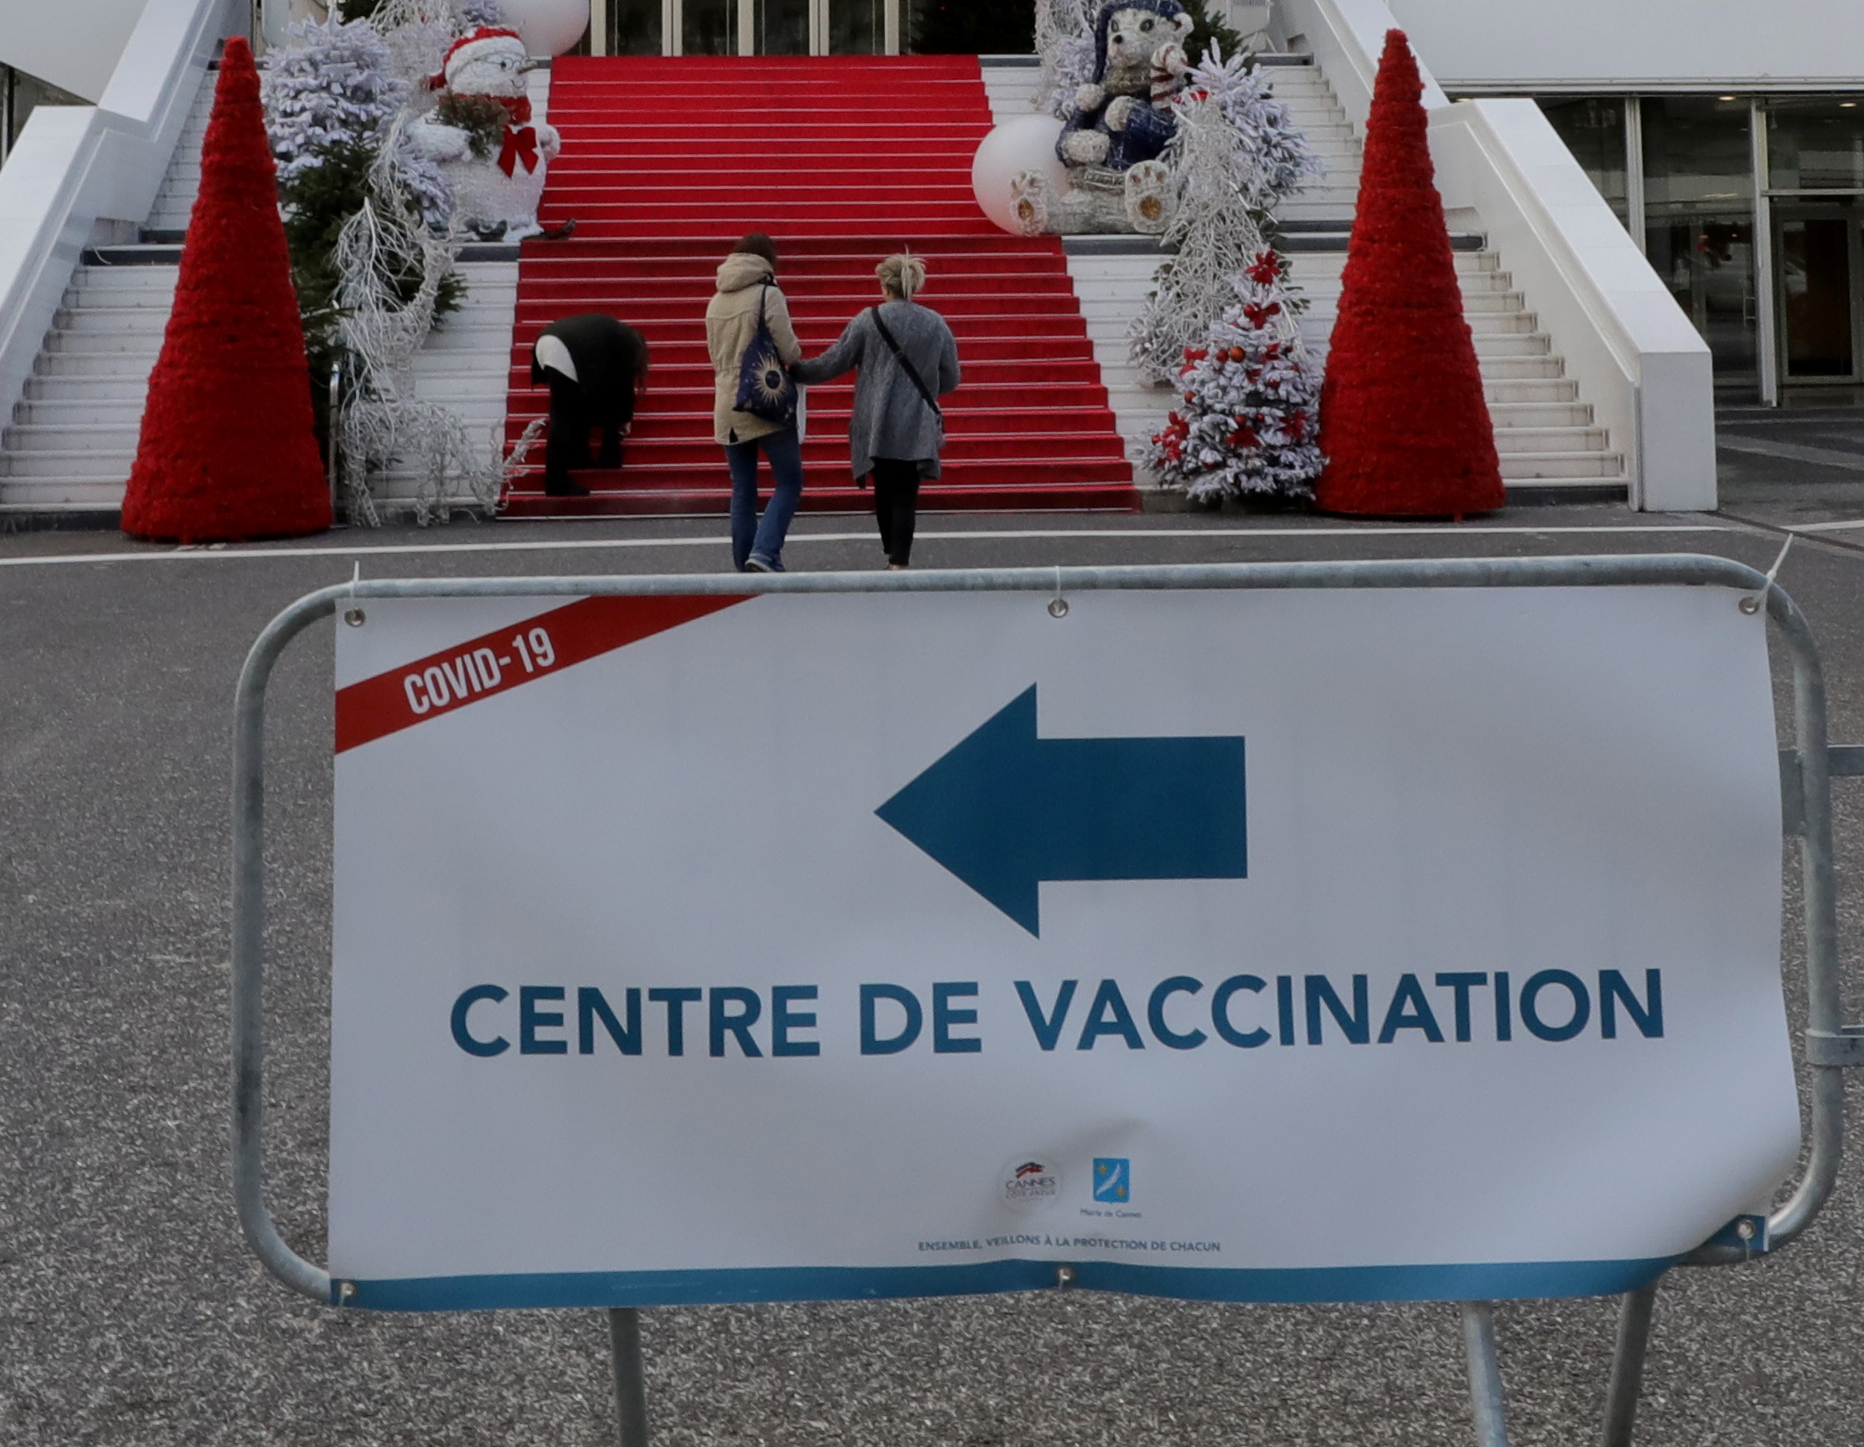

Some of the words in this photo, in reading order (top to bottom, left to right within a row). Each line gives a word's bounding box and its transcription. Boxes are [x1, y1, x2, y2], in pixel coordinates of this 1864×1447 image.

[403, 627, 557, 715] COVID-19
[449, 983, 821, 1059] CENTRE
[857, 982, 983, 1056] DE
[1013, 966, 1666, 1054] VACCINATION
[1005, 1177, 1056, 1190] CANNES
[985, 1234, 1041, 1247] VEILLONS
[1044, 1234, 1053, 1246] À
[1055, 1237, 1071, 1247] LA
[1073, 1238, 1147, 1251] PROTECTION
[1151, 1241, 1167, 1251] DE
[1169, 1241, 1221, 1252] CHACUN
